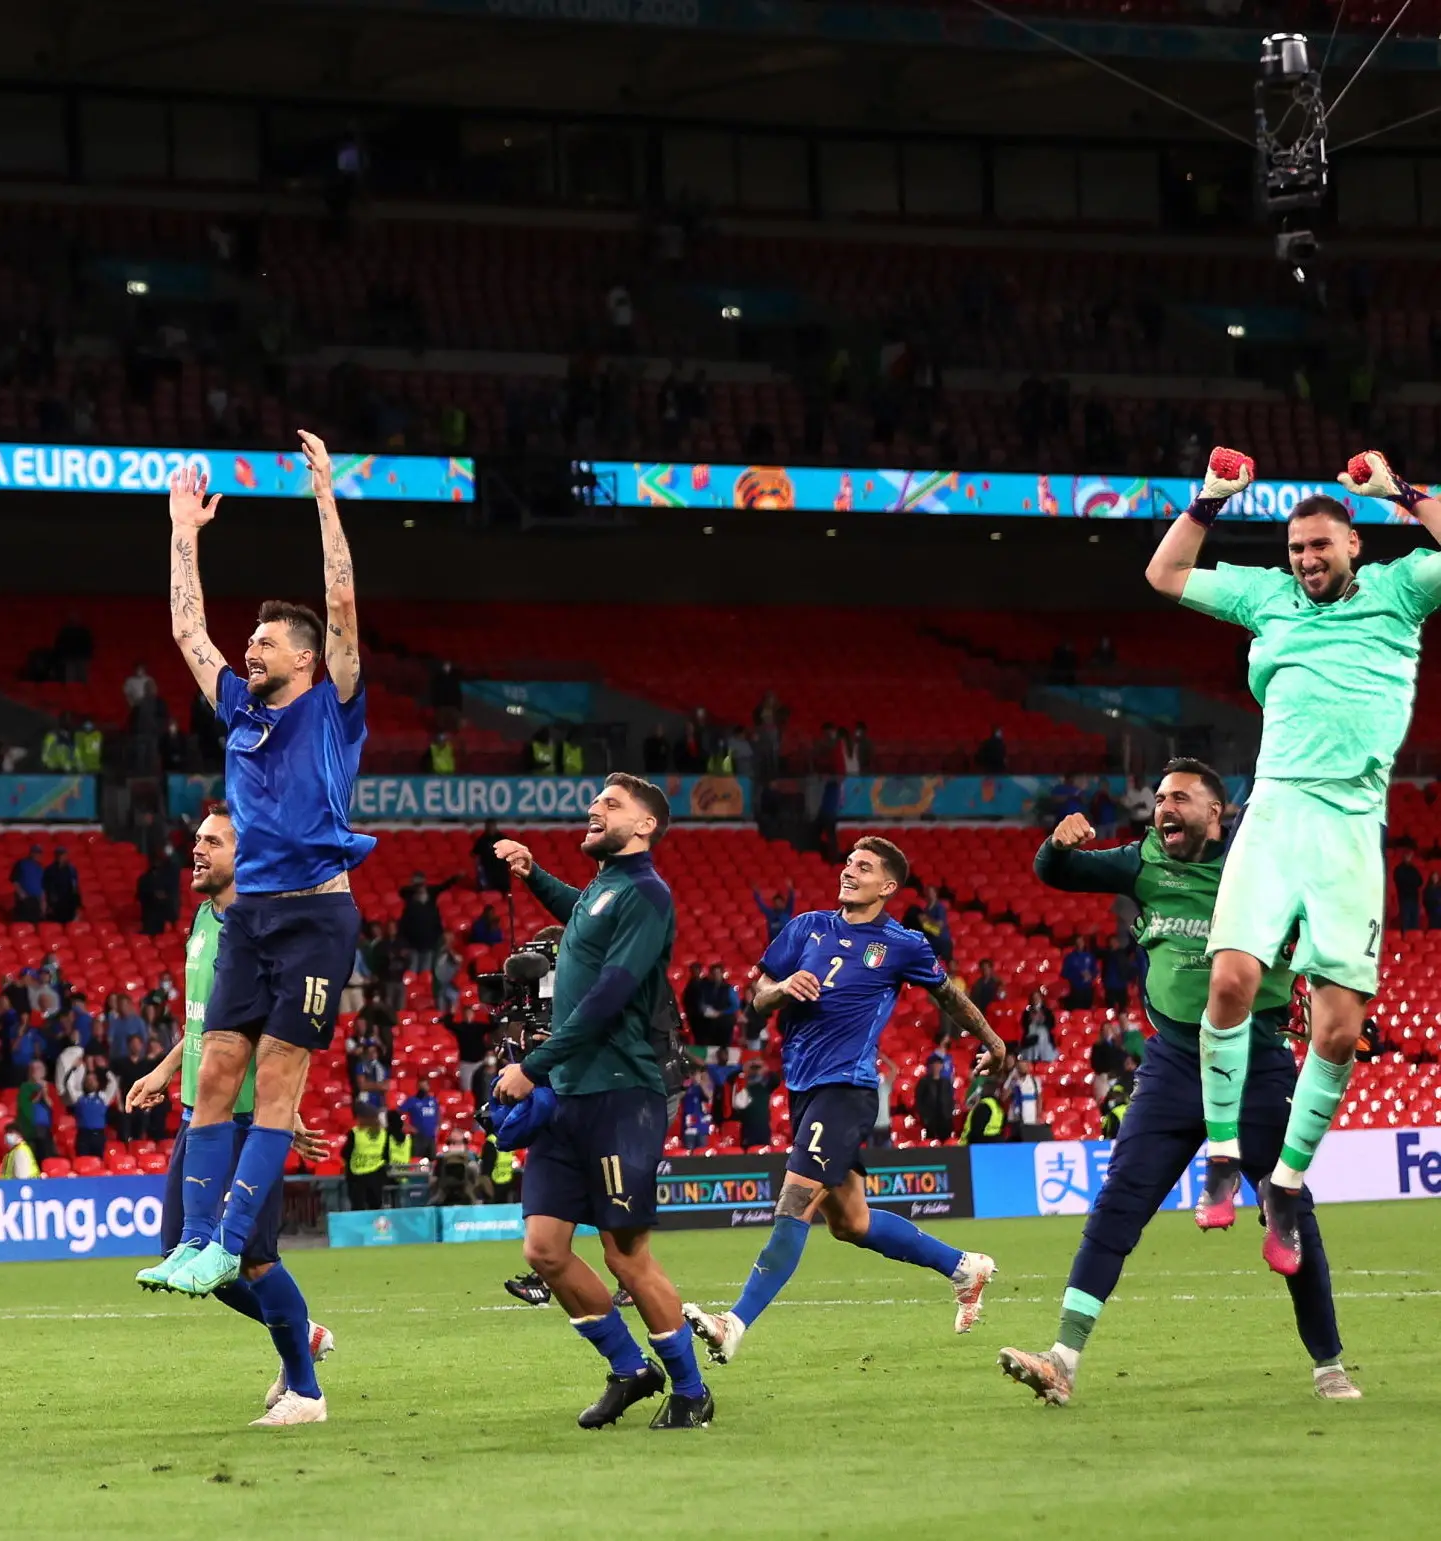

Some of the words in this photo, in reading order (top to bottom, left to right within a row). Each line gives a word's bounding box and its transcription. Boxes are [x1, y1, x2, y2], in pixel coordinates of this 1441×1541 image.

[13, 449, 111, 487] EURO
[423, 780, 512, 814] EURO
[518, 780, 597, 814] 2020
[1364, 918, 1380, 958] 2
[822, 956, 843, 988] 2
[303, 976, 329, 1016] 15
[807, 1121, 824, 1153] 2
[601, 1154, 623, 1196] 11
